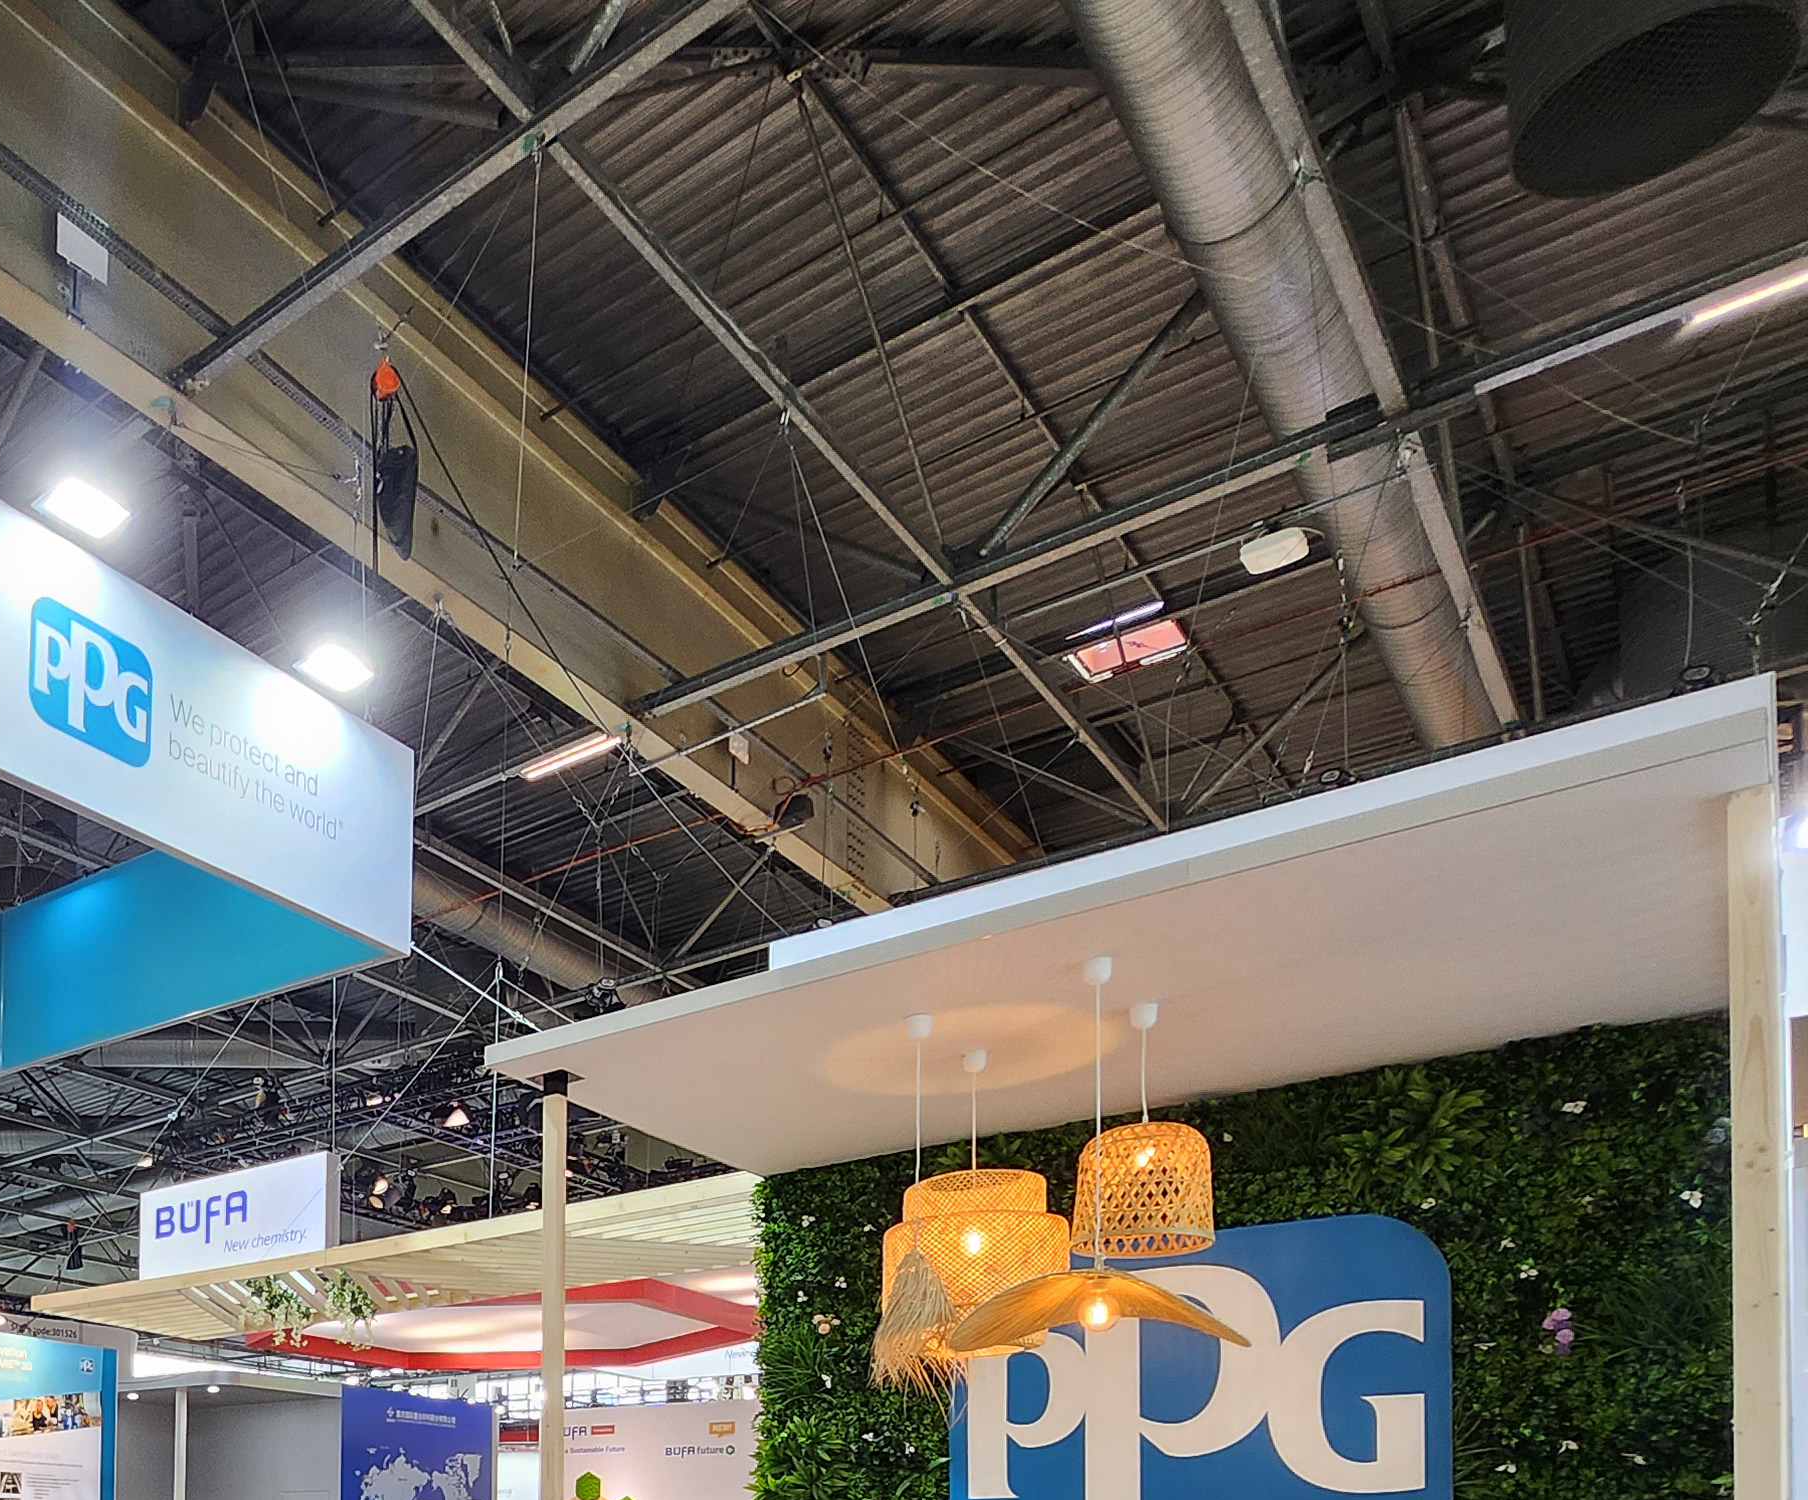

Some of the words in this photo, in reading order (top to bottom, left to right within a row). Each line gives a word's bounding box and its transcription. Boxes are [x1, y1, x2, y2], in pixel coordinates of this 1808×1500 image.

[34, 619, 149, 744] PPG
[169, 693, 205, 736] We
[210, 721, 280, 778] protect
[284, 764, 319, 798] and
[168, 731, 250, 800] beautify
[254, 780, 286, 814] the
[155, 1189, 248, 1245] BÜFA
[223, 1238, 250, 1254] New
[250, 1227, 308, 1249] chemistry.
[21, 1361, 33, 1372] 3D
[80, 1359, 94, 1373] PPG
[569, 1446, 604, 1454] Sustainable
[697, 1445, 725, 1455] future
